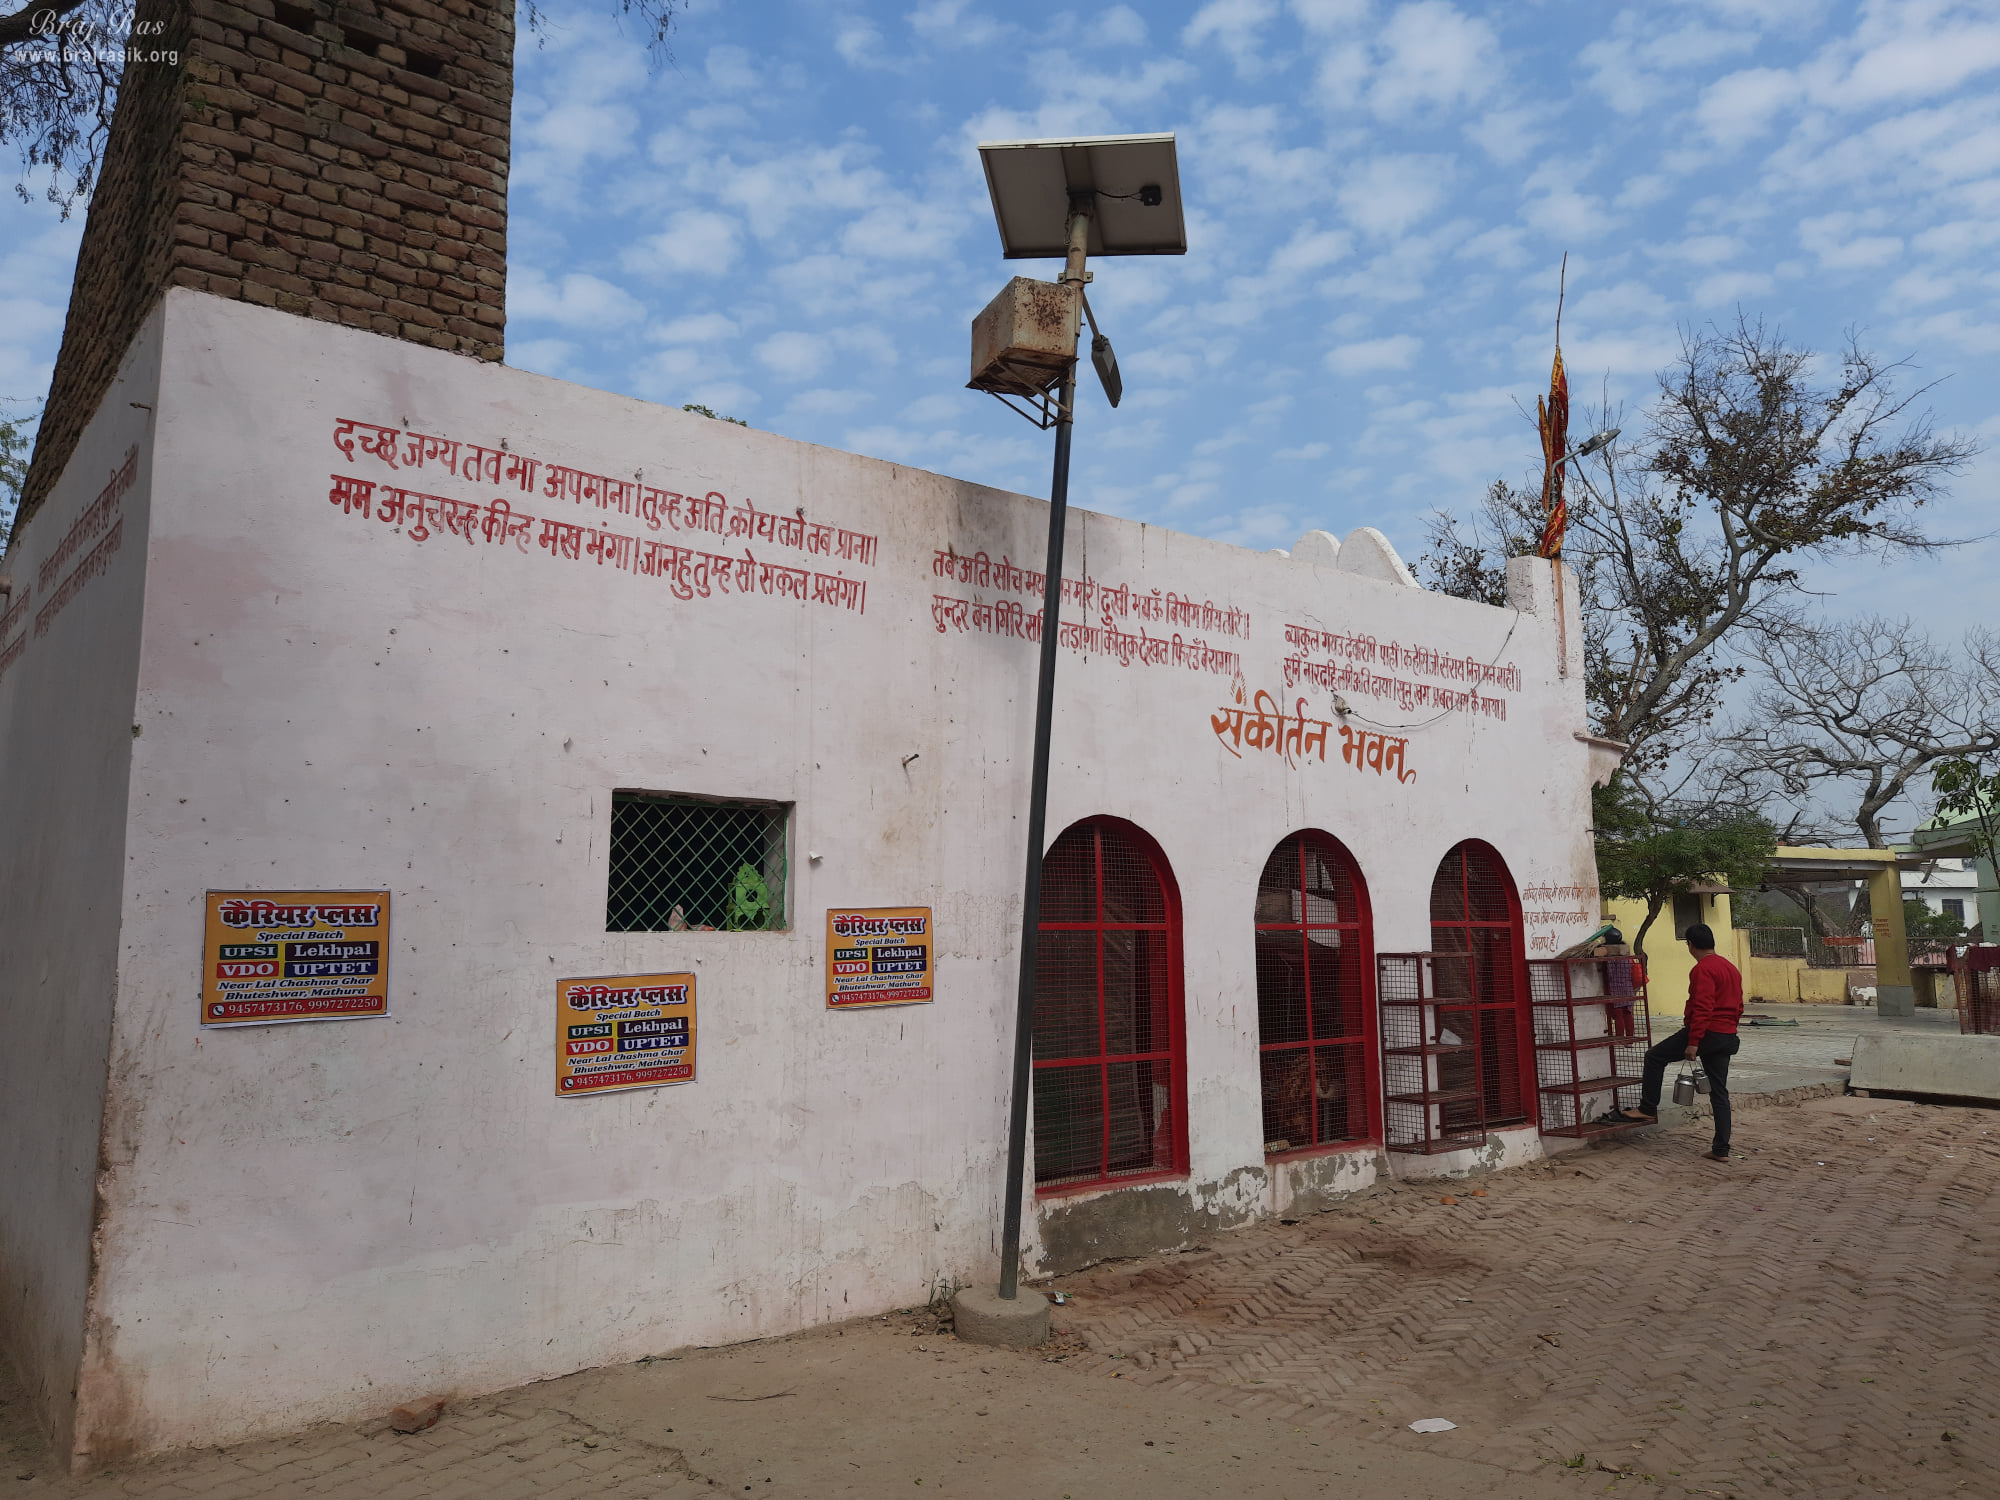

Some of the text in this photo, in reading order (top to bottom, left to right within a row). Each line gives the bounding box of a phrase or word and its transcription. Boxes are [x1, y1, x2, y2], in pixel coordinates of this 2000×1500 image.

[402, 432, 462, 475] जग्य
[463, 444, 506, 484] तव
[506, 454, 542, 492] भा
[642, 486, 683, 531] तुम्ह
[684, 492, 728, 534] अति
[725, 498, 778, 543] क्रोध
[807, 522, 835, 556] तब
[329, 474, 376, 519] मम
[481, 498, 535, 554] कीन्ह
[538, 518, 585, 560] मख
[640, 540, 694, 600] जानहु
[693, 551, 734, 598] तुम्ह
[735, 547, 757, 593] सो
[759, 562, 811, 600] सकल
[933, 549, 955, 581] तब
[958, 551, 991, 588] अति
[993, 555, 1023, 595] सोच
[1202, 600, 1222, 632] प्रिय
[931, 594, 969, 634] सुन्दर
[972, 604, 993, 634] बन
[995, 599, 1025, 640] गिरि
[1139, 626, 1169, 666] देखत
[218, 899, 376, 926] कैरियर प्लस
[258, 930, 343, 942] Special Batch
[855, 937, 905, 947] Special Batch
[224, 943, 371, 959] UPSI Lekhpal
[877, 947, 922, 959] Lekhpal
[221, 961, 371, 976] VDO UPTET
[835, 961, 922, 973] VDO UPTET
[219, 976, 372, 990] Near Lal Chashma Ghar
[225, 987, 365, 1000] Bhuteshwar, Mathura
[567, 985, 684, 1008] कैरियर प्लस
[308, 998, 378, 1010] 9997272250
[596, 1009, 660, 1020] Special Batch
[571, 1019, 683, 1036] UPSI Lekhpal
[570, 1035, 683, 1053] VDO UPTET
[568, 1057, 593, 1065] Near
[614, 1051, 658, 1060] Chashma
[661, 1048, 685, 1056] Ghar
[638, 1058, 679, 1068] Mathura
